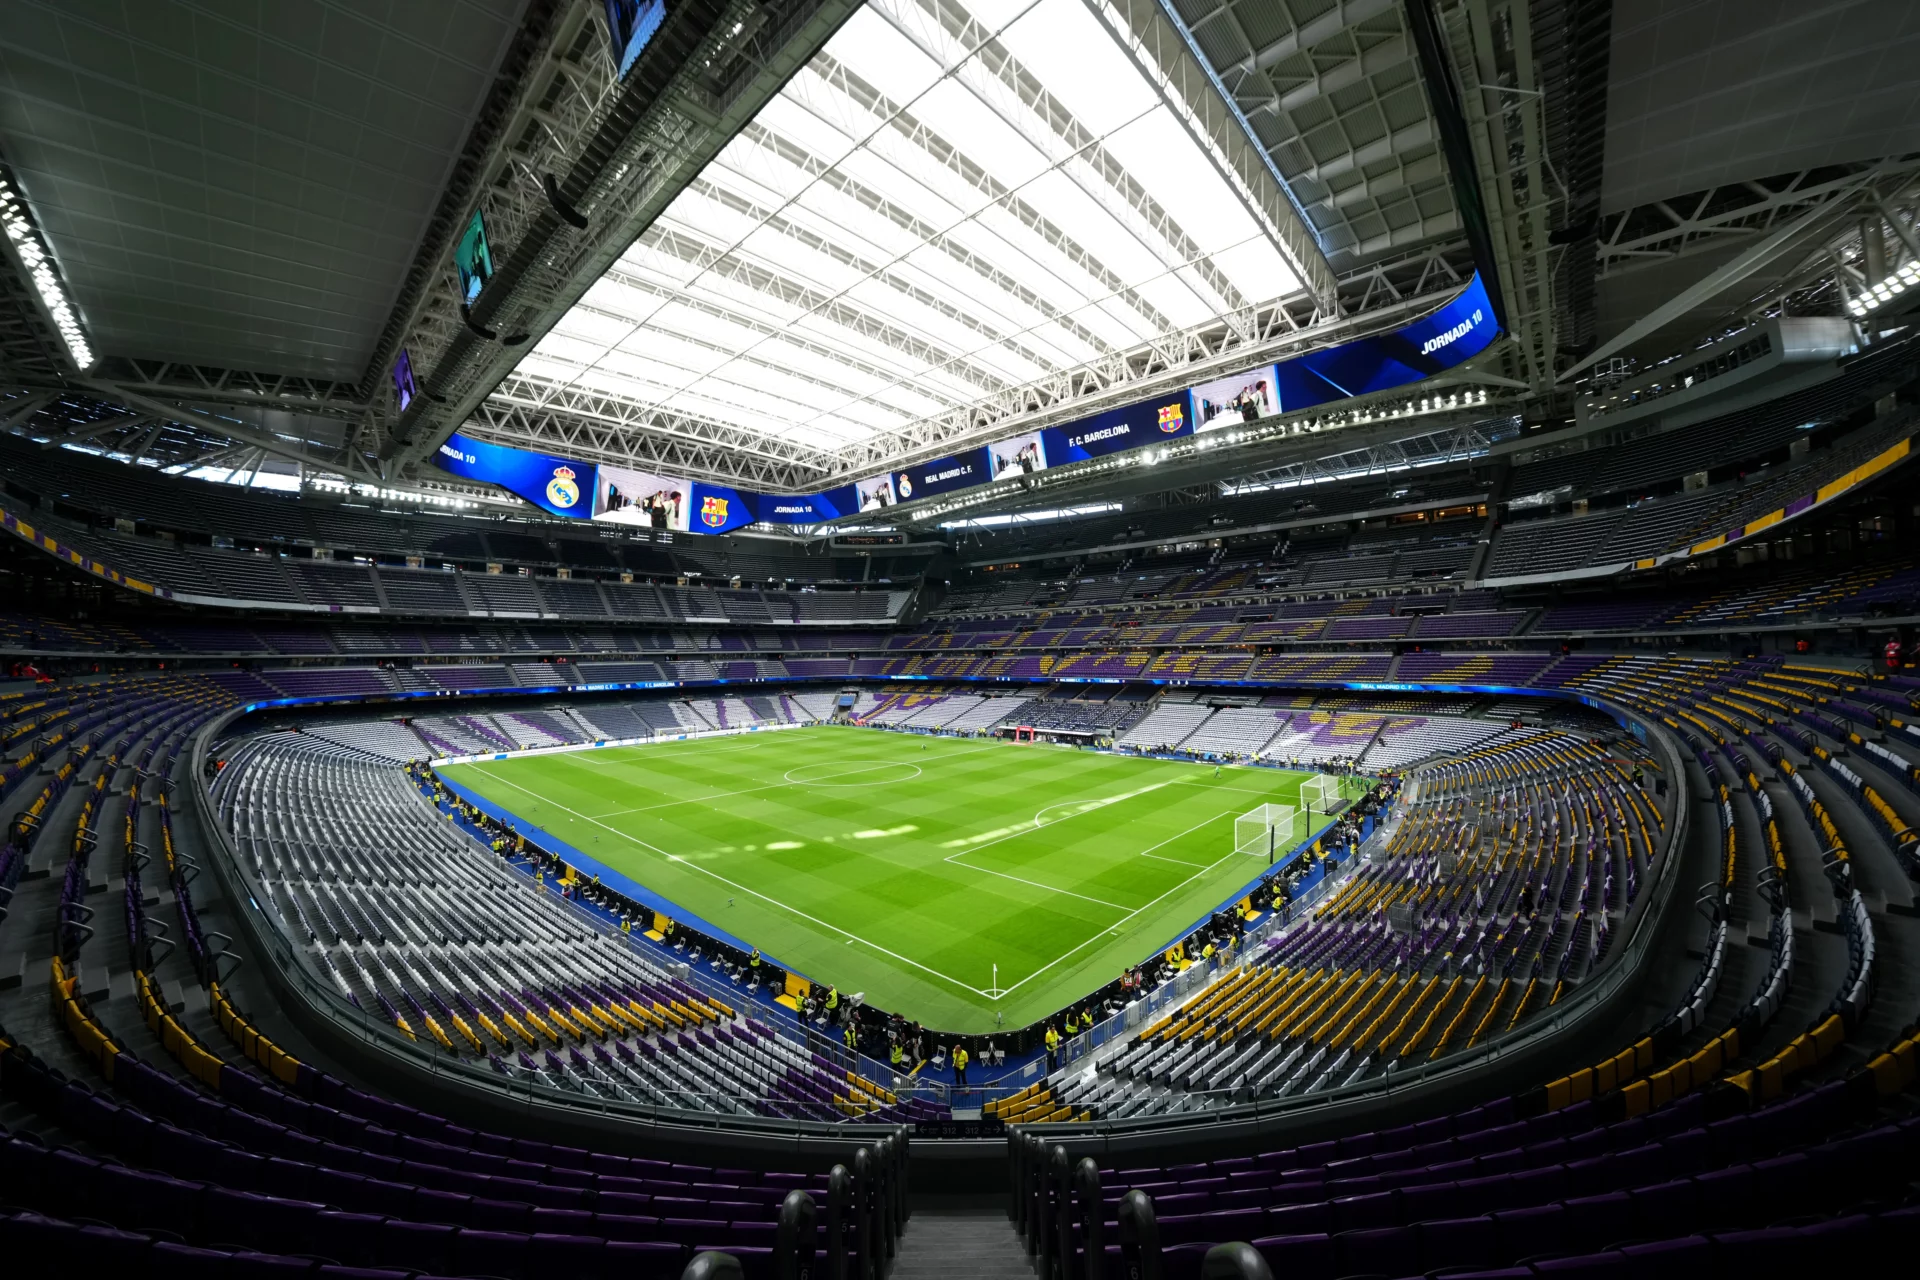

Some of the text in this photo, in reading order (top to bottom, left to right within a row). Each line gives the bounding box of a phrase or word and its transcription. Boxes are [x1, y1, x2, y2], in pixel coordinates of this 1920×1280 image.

[1421, 308, 1483, 355] JORNADA 10
[1068, 423, 1130, 447] F. C. BARCELONA
[465, 454, 476, 464] 10
[925, 464, 973, 484] REAL MADRID C. F.
[774, 505, 812, 513] JORNADA 10
[941, 1126, 957, 1135] 312
[964, 1126, 980, 1135] 312
[841, 1222, 848, 1233] 5
[1130, 1266, 1139, 1280] 6
